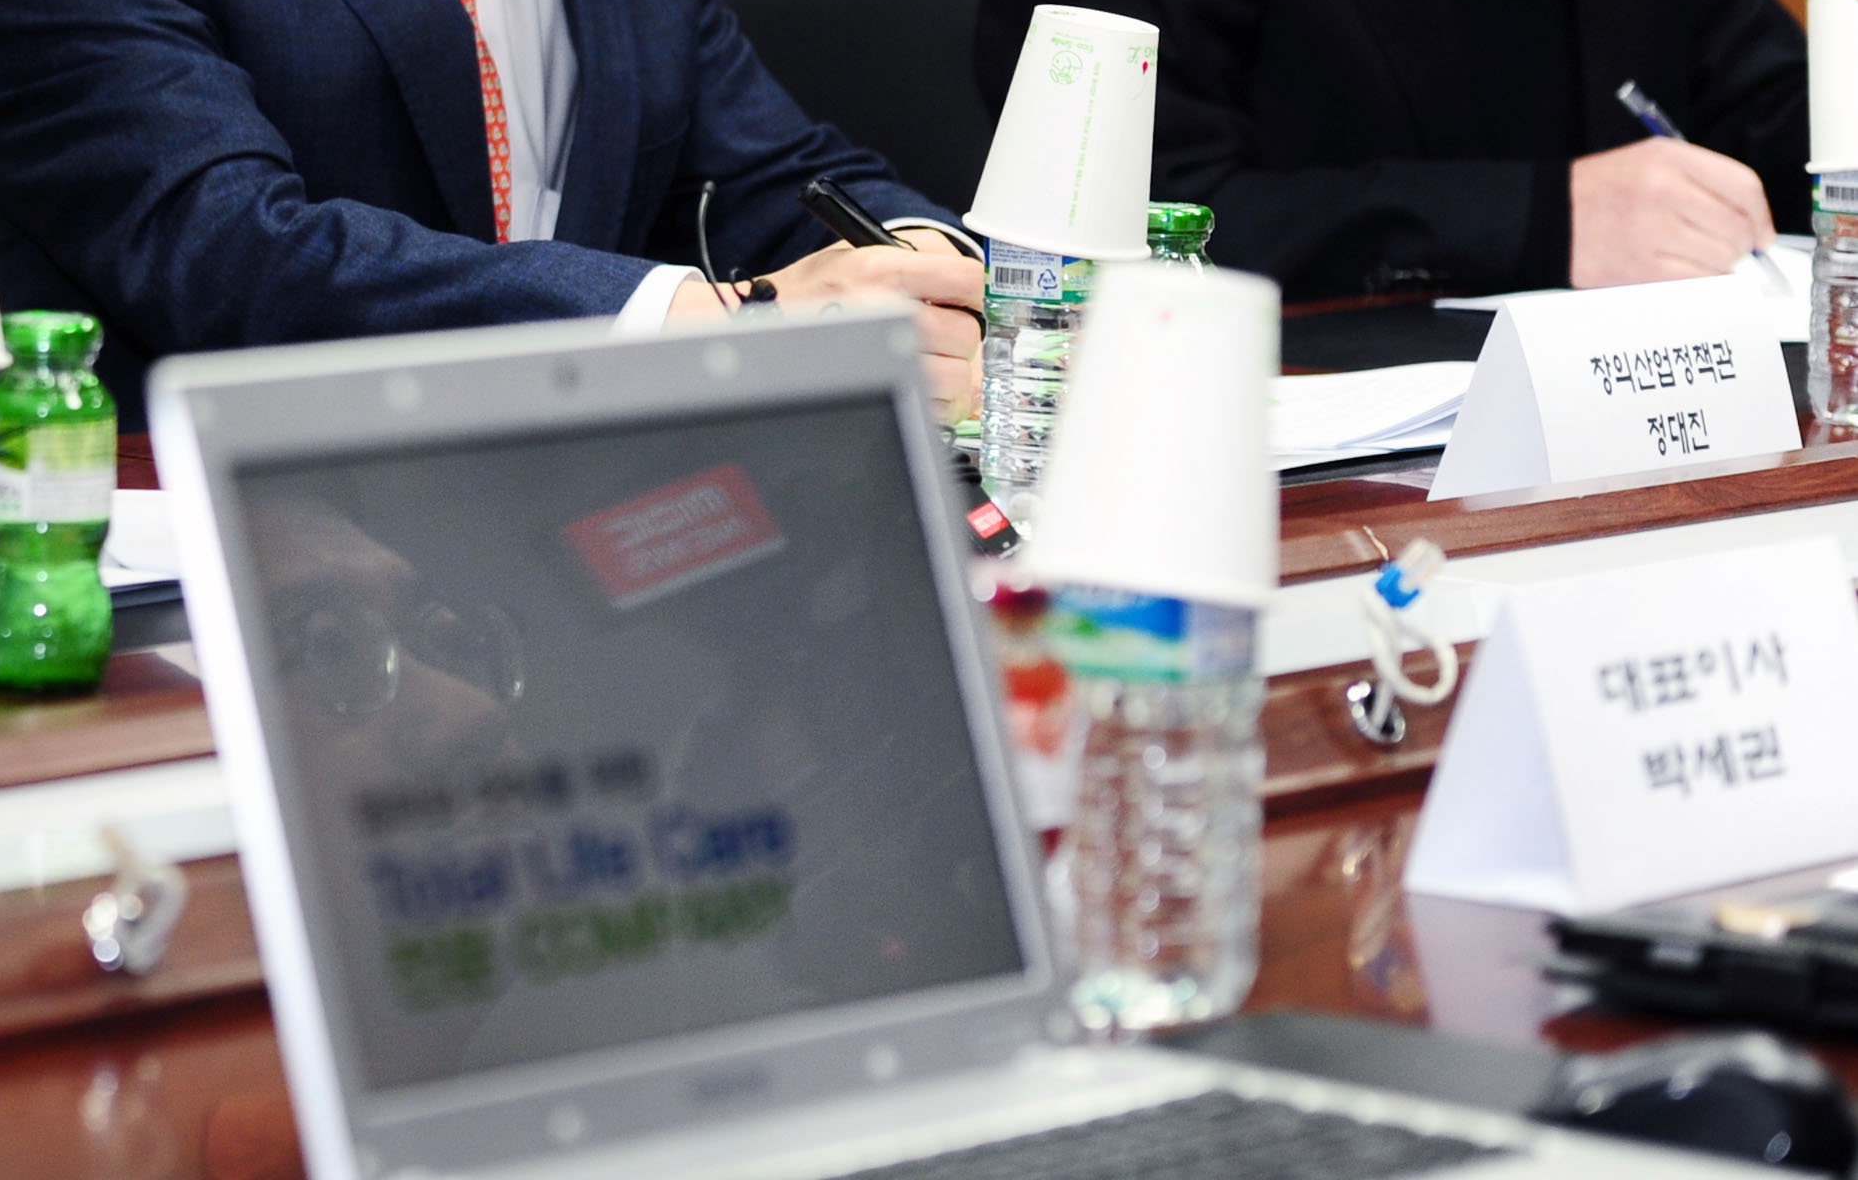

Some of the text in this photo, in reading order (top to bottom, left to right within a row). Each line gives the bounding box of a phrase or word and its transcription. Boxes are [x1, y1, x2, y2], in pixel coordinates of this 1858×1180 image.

[1590, 339, 1737, 395] 창의산업정책관
[1647, 408, 1710, 456] 정대진
[1596, 630, 1790, 714] 대표이사
[1642, 721, 1788, 798] 박세권
